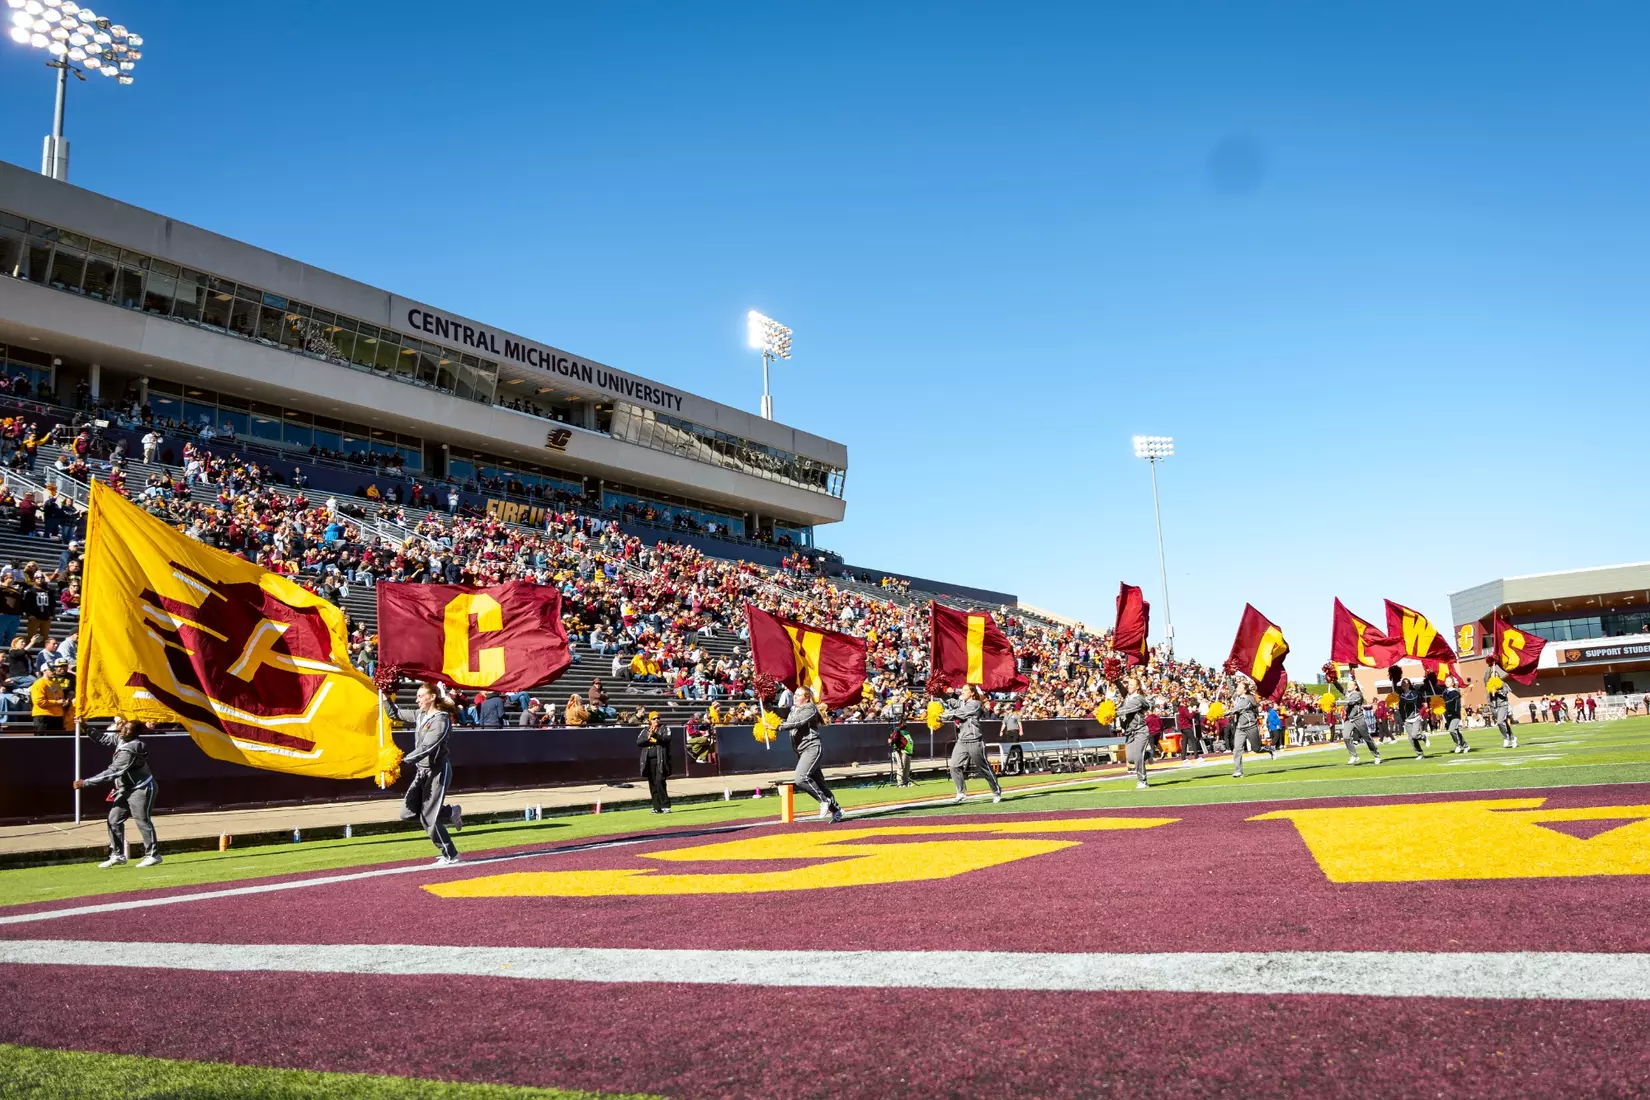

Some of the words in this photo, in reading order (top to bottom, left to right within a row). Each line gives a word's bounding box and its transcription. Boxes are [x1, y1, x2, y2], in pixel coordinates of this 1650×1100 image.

[408, 308, 500, 354] CENTRAL
[504, 339, 593, 384] MICHIGAN
[596, 369, 683, 412] UNIVERSITY
[442, 593, 505, 687] C
[1502, 629, 1526, 671] S
[1585, 647, 1621, 658] SUPPORT
[1623, 645, 1650, 655] STUDE
